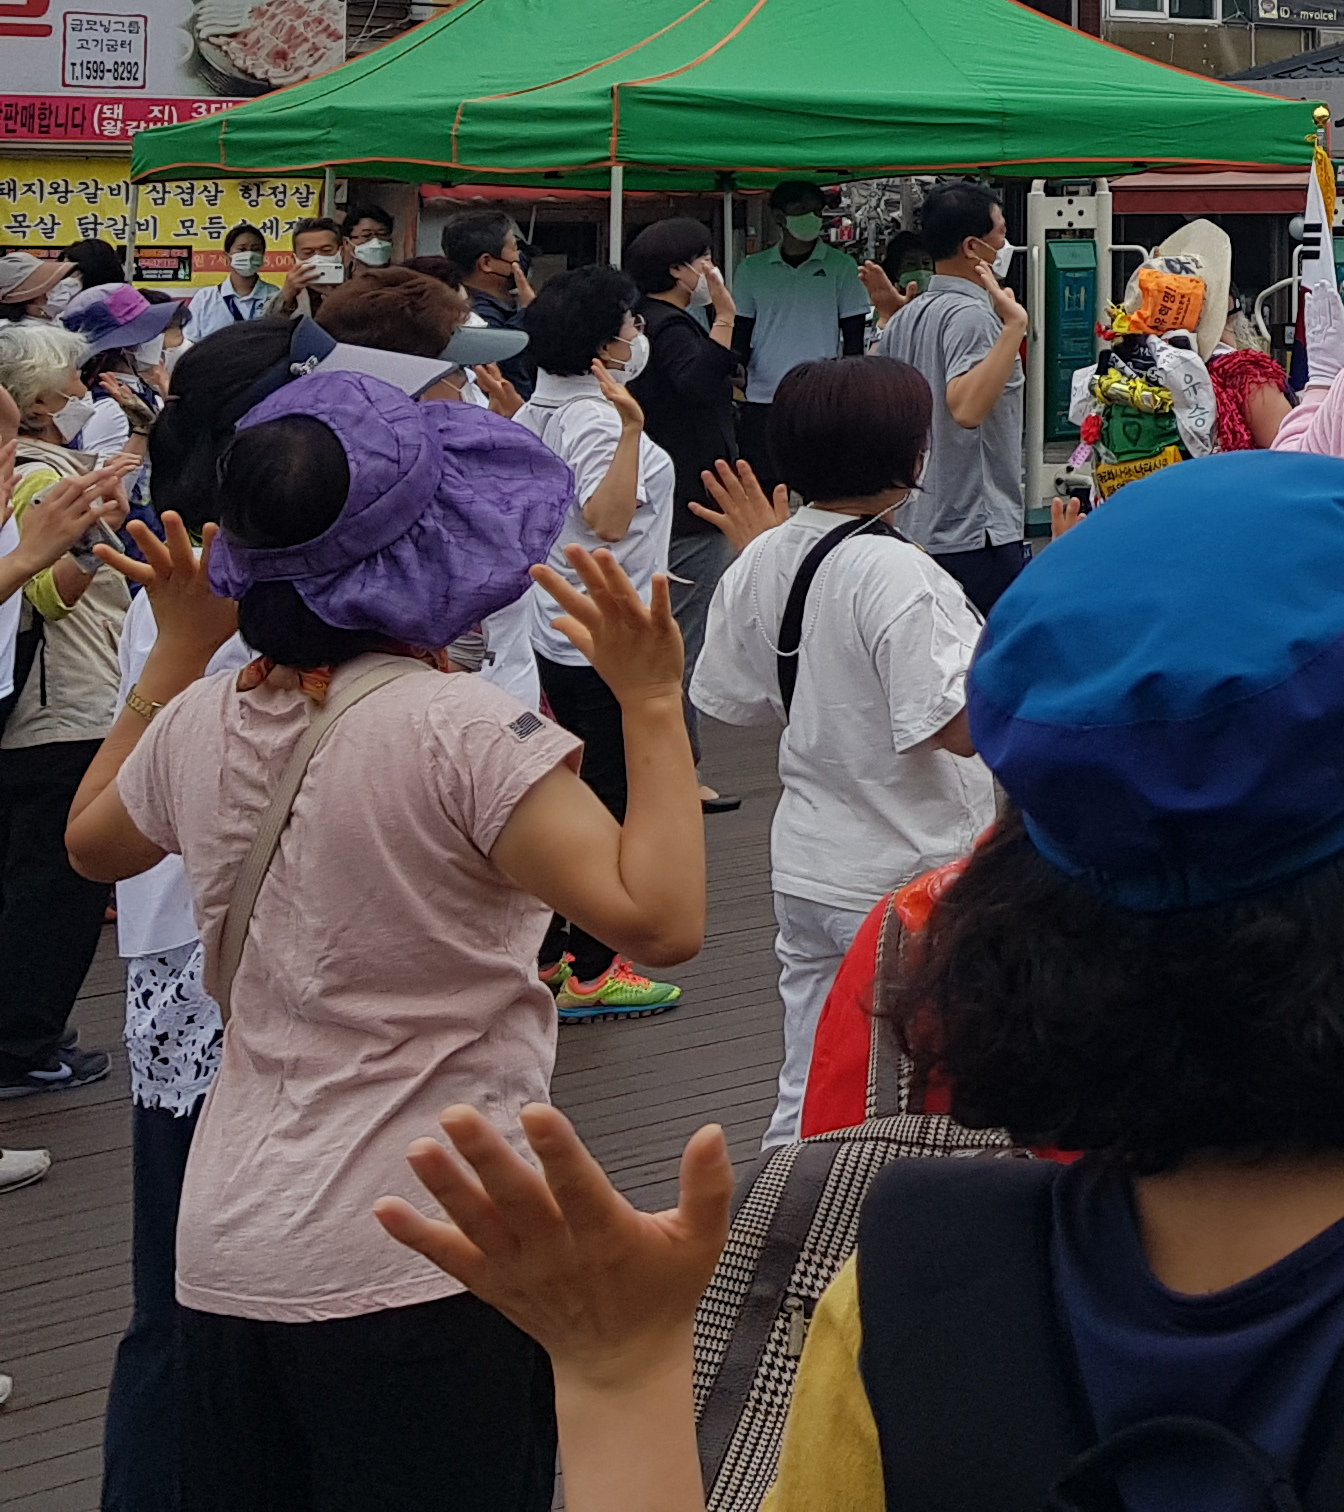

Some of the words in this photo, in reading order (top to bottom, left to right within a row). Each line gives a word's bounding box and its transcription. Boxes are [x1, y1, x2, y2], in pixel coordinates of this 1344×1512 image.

[70, 60, 139, 81] T.1599-8292
[3, 101, 87, 136] 판매합니다
[144, 180, 225, 207] 삼겹살
[239, 181, 316, 209] 항정살
[4, 213, 61, 241] 목살
[76, 213, 160, 241] 닭갈비
